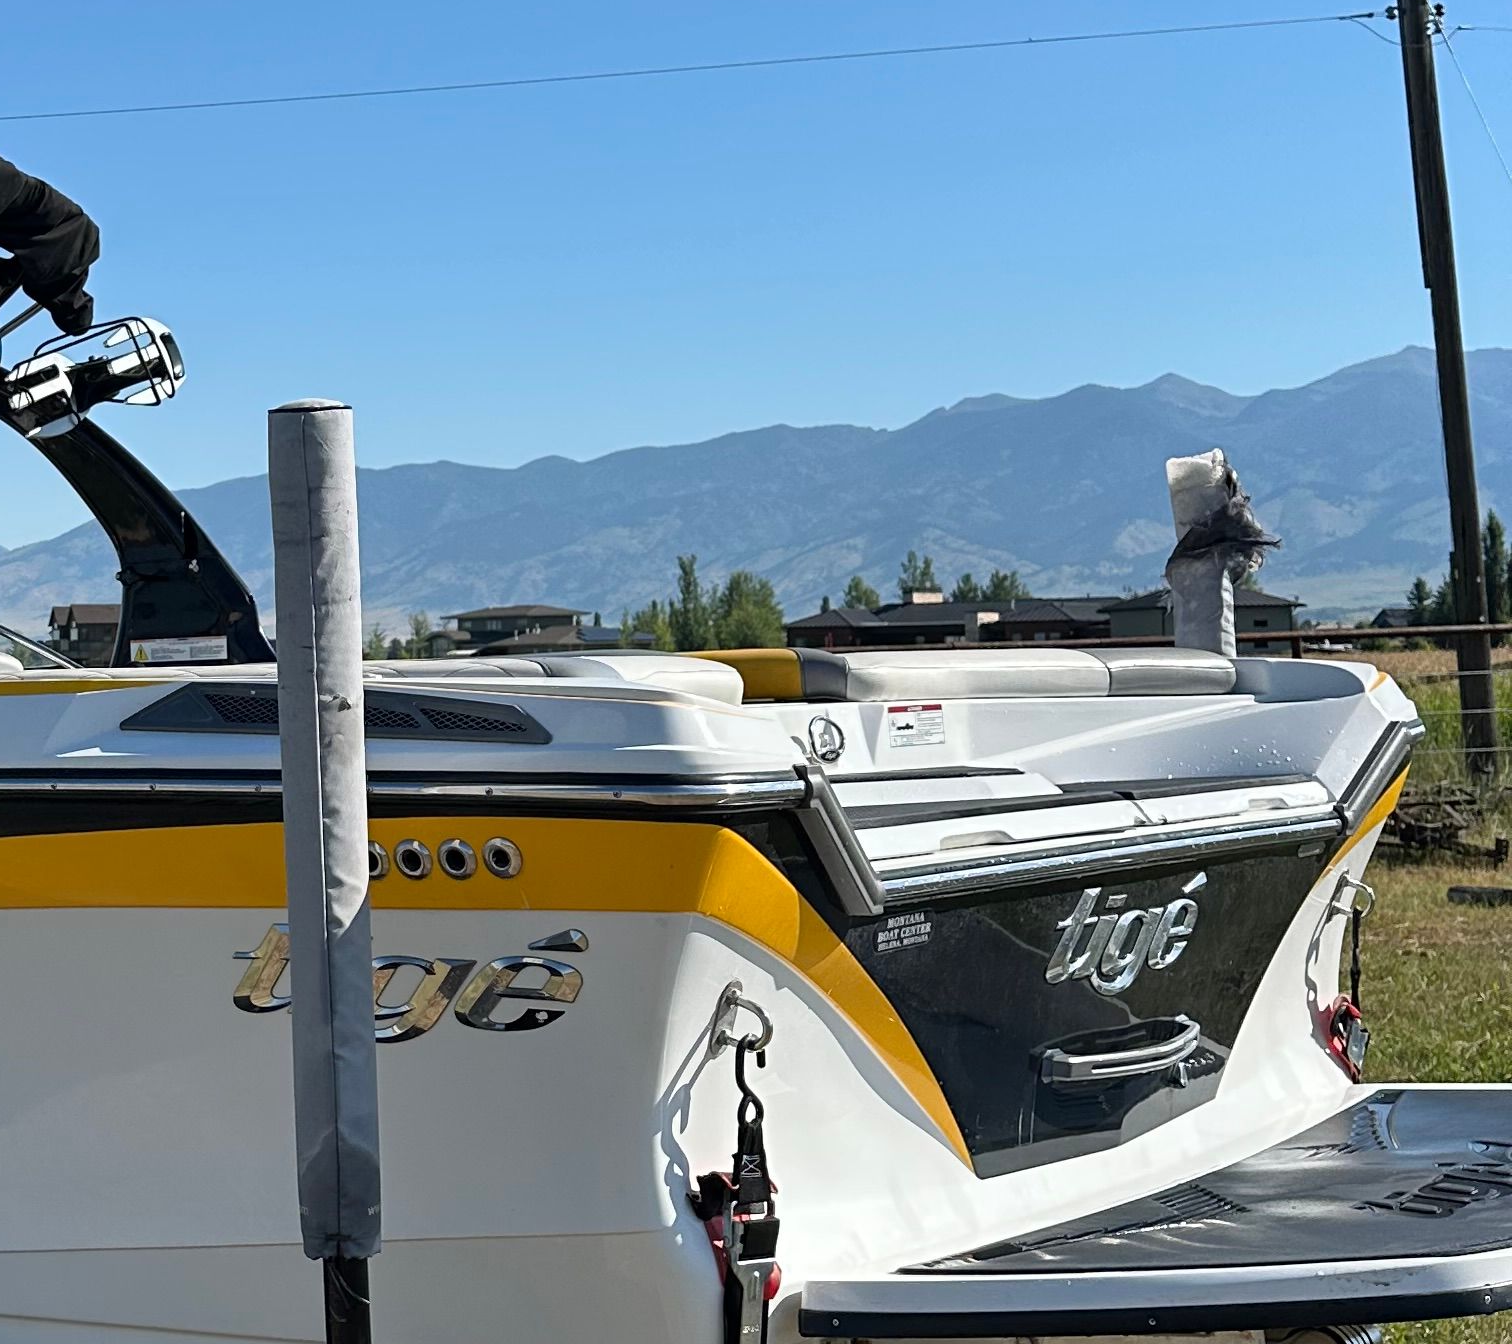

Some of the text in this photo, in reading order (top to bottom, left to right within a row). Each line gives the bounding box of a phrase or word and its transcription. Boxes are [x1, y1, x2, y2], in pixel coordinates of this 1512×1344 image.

[877, 922, 932, 943] BOAT CENTER
[886, 911, 925, 929] MONTANA
[1044, 871, 1208, 996] tigé
[232, 922, 590, 1044] tgé
